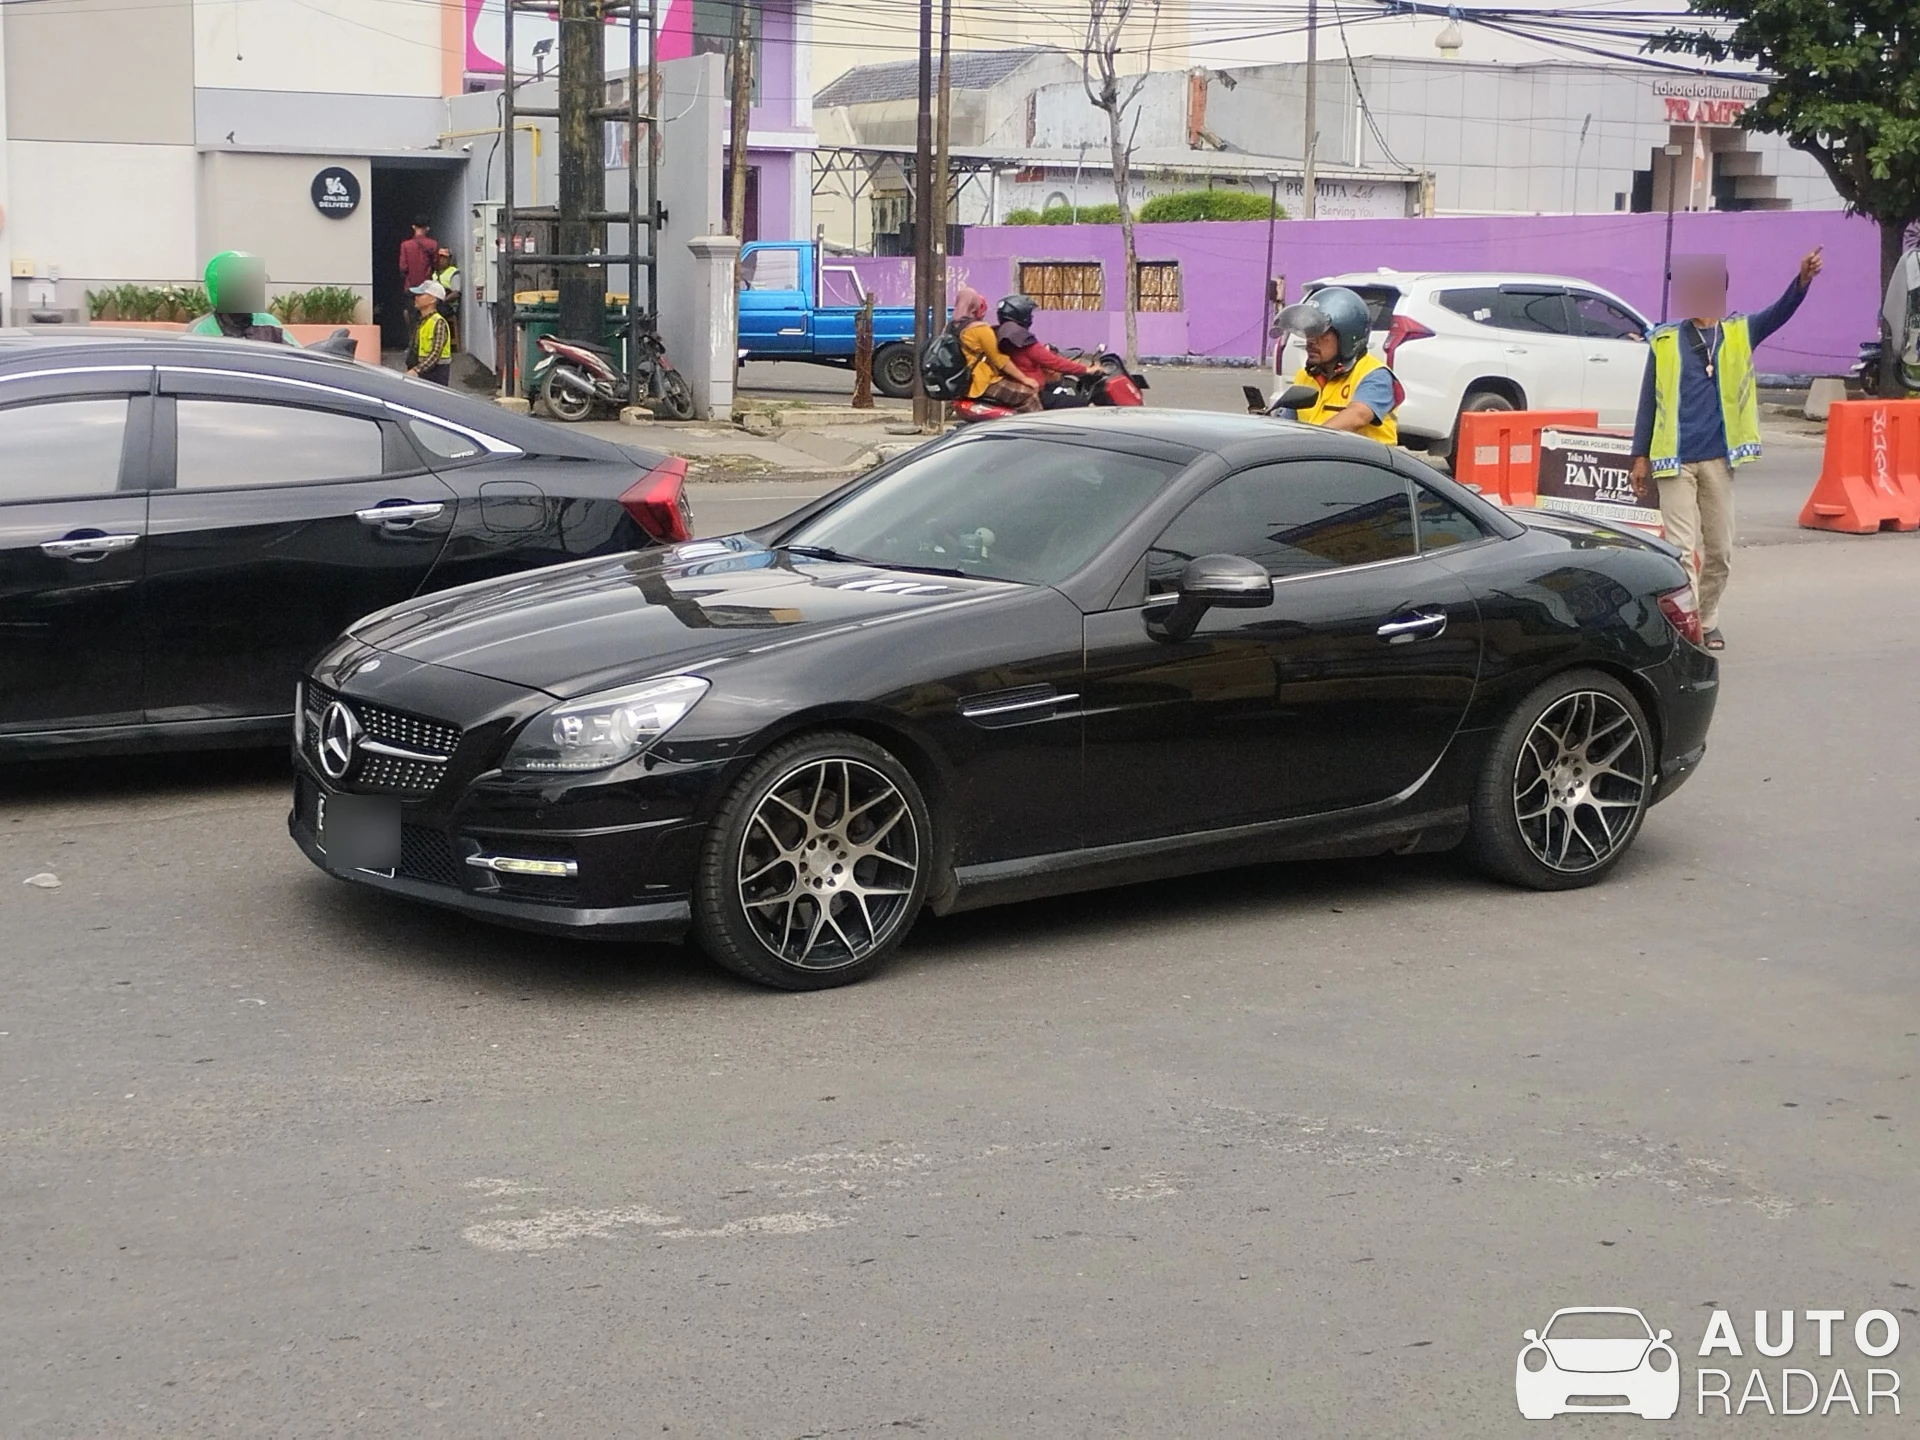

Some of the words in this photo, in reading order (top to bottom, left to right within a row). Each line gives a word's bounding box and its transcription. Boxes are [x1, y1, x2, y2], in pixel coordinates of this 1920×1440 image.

[1653, 81, 1731, 98] Laboratorium
[1664, 97, 1746, 124] PRAMIT
[1286, 182, 1347, 198] PRMITA
[1321, 205, 1356, 218] Serving
[1359, 206, 1374, 218] You
[1611, 443, 1632, 451] CIREBO
[1566, 452, 1583, 463] Toko
[1564, 463, 1635, 492] PANTE
[1628, 508, 1658, 522] LINTAS
